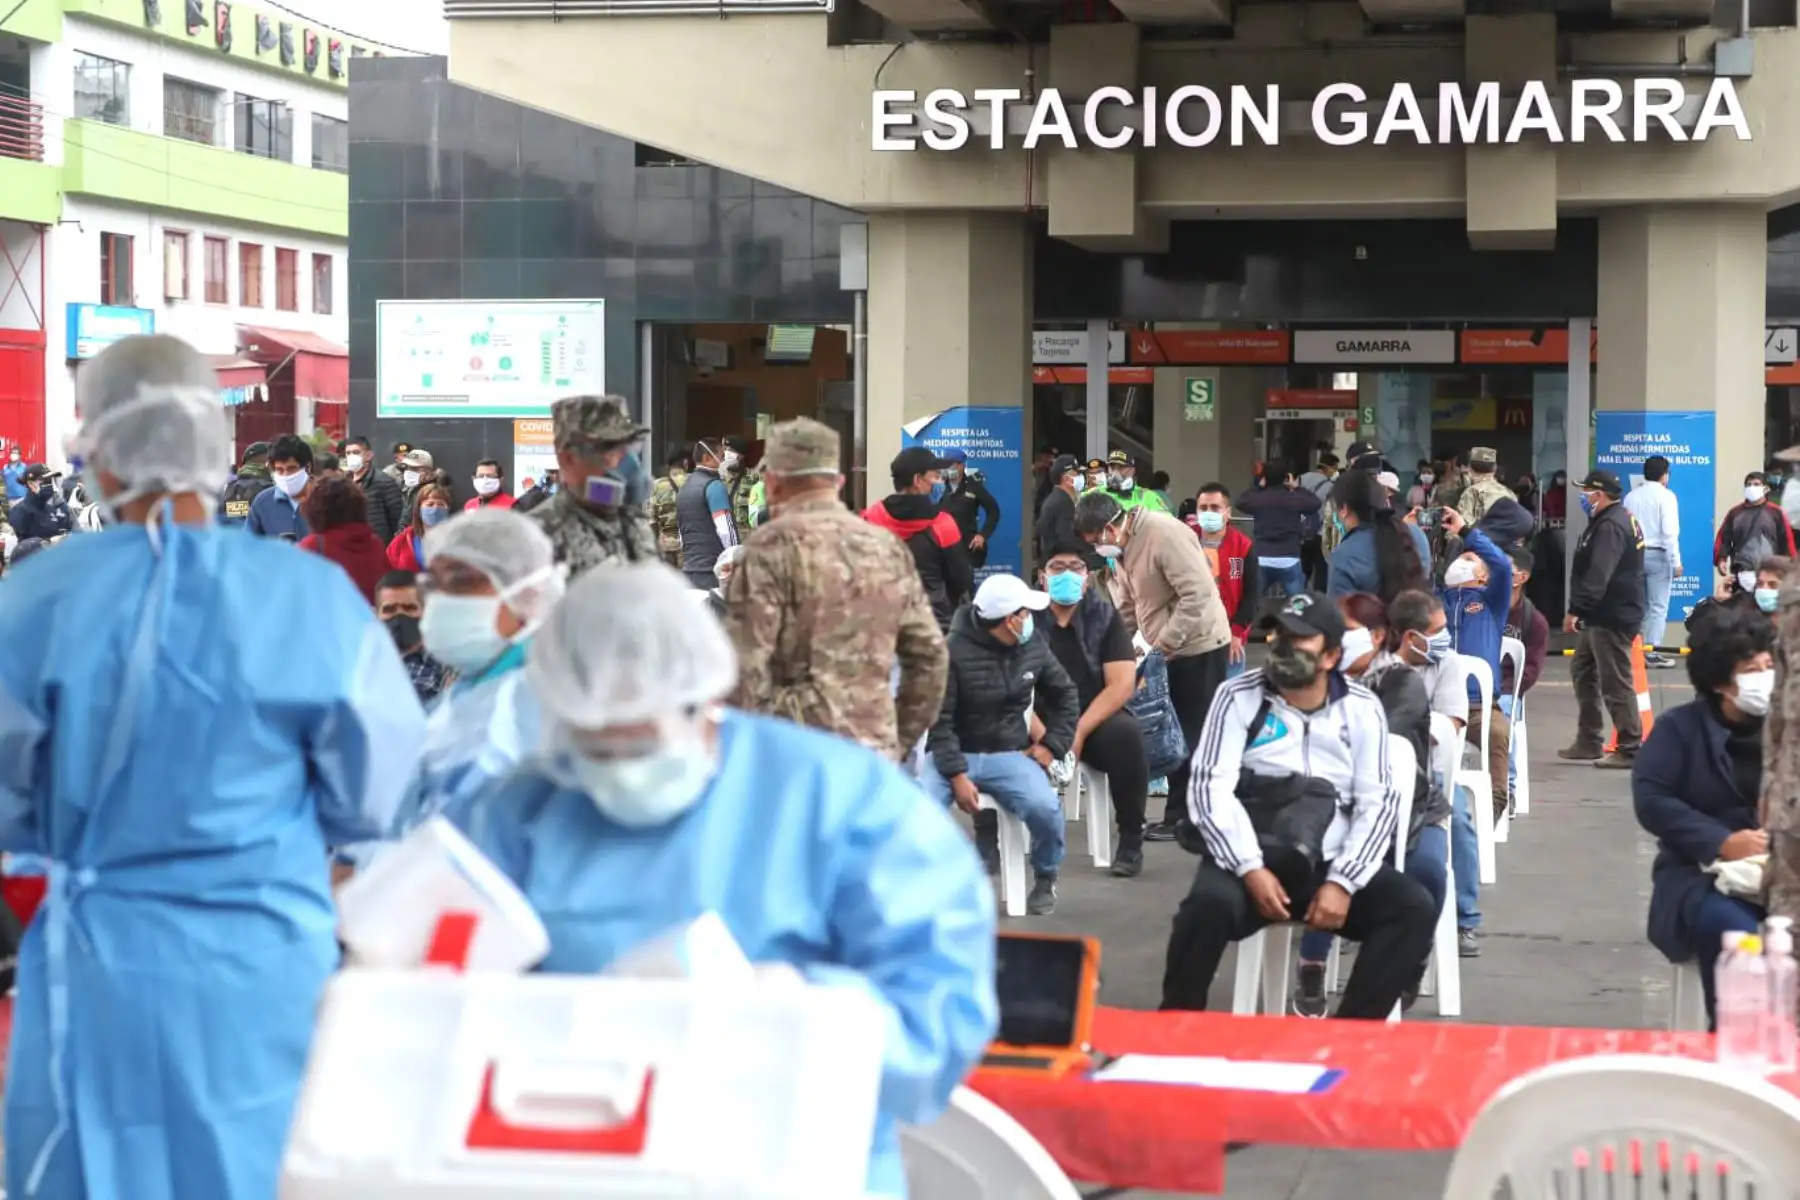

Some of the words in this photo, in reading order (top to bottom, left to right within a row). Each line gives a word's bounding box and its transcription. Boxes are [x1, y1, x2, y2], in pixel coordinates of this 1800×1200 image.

[871, 84, 1280, 151] ESTACION
[1311, 77, 1752, 146] GAMARRA
[1336, 340, 1411, 352] GAMARRA
[1190, 380, 1209, 403] S
[1364, 407, 1373, 423] S
[941, 428, 975, 437] RESPETA
[976, 428, 989, 437] LAS
[1624, 433, 1652, 442] RESPETA
[1654, 433, 1671, 442] LAS
[923, 439, 960, 448] MEDIDAS
[961, 439, 1004, 448] PERMITIDAS
[1610, 444, 1638, 454] MEDIDAS
[1639, 444, 1690, 454] PERMITIDAS
[976, 450, 991, 459] CON
[993, 450, 1018, 459] BULTOS
[1598, 455, 1614, 464] PARA
[1623, 456, 1647, 464] INGRES
[1675, 456, 1710, 465] BULTOS
